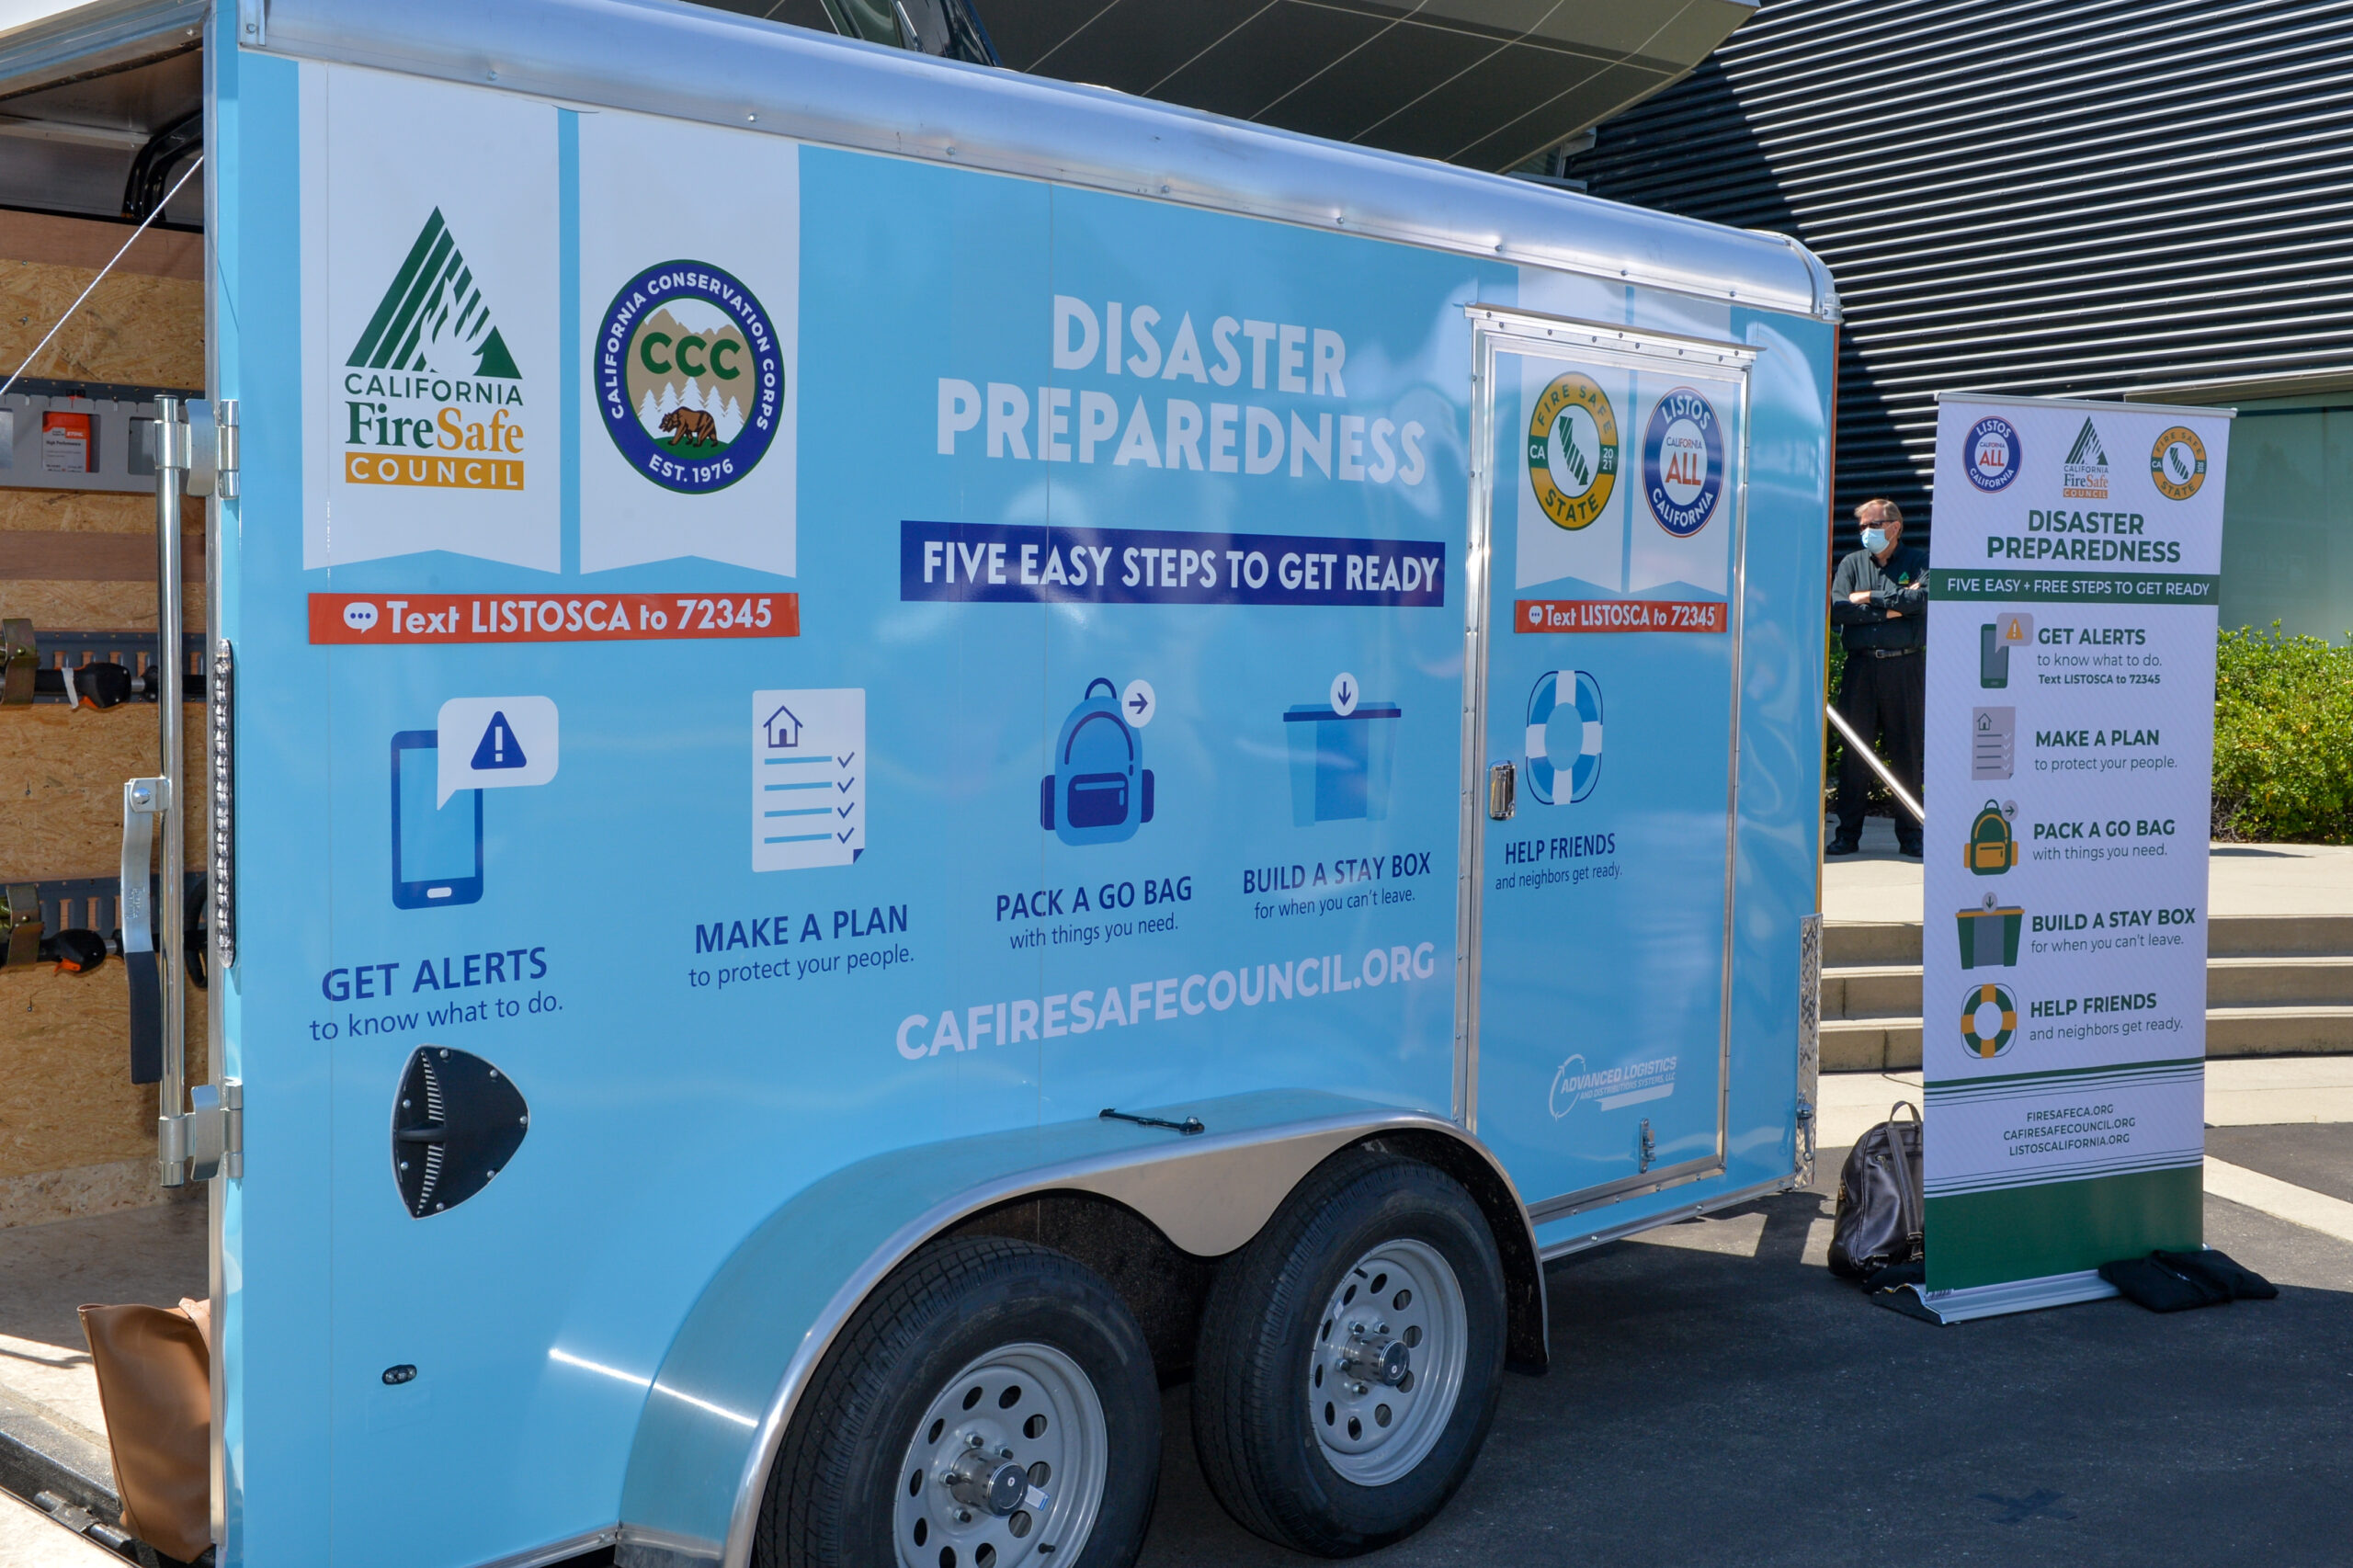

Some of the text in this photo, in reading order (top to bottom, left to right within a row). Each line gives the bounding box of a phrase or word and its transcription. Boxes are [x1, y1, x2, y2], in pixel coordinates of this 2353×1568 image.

[605, 272, 775, 430] CALIFORNIA CONSERVATION CORPS
[641, 332, 741, 381] CCC
[1053, 294, 1346, 398] DISASTER
[345, 373, 524, 406] CALIFORNIA
[1538, 384, 1611, 434] FIRE SAFE
[1661, 394, 1711, 430] LISTOS
[345, 401, 524, 454] FireSafe
[938, 377, 1426, 486] PREPAREDNESS
[1976, 420, 2011, 437] LISTOS
[1529, 445, 1545, 460] CA
[1603, 448, 1613, 459] 20
[1666, 436, 1702, 449] CALIFORNIA
[2155, 432, 2201, 454] FIRE SAFE
[649, 454, 733, 483] EST. 1976
[1603, 460, 1612, 471] 21
[1665, 452, 1701, 486] ALL
[1979, 449, 2005, 467] ALL
[2063, 465, 2109, 473] CALIFORNIA
[2152, 460, 2162, 469] CA
[350, 457, 518, 486] COUNCIL
[1970, 467, 2014, 488] CALIFORNIA
[2063, 473, 2109, 488] FireSafe
[2064, 489, 2107, 497] COUNCIL
[2161, 481, 2195, 497] STATE
[1545, 488, 1599, 522] STATE
[1653, 487, 1714, 528] CALIFORNIA
[2029, 509, 2144, 535] DISASTER
[1987, 536, 2181, 562] PREPAREDNESS
[924, 540, 1439, 593] FIVE EASY STEPS TO GET READY
[1948, 578, 1980, 592] FIVE
[1985, 579, 2020, 593] EASY
[2034, 579, 2068, 593] FREE
[2072, 580, 2112, 594] STEPS
[2114, 581, 2133, 595] TO
[2136, 582, 2163, 595] GET
[2165, 582, 2210, 597] READY
[387, 598, 771, 633] Text LISTOSCA to 72345
[1545, 604, 1715, 627] Text LISTOSCA to 72345
[2038, 628, 2146, 645] GET ALERTS
[2037, 653, 2162, 666] to know what to do.
[2038, 674, 2161, 685] Text LISTOSCA to 72345
[2036, 729, 2159, 747] MAKE A PLAN
[2034, 756, 2177, 773] to protect your people.
[2033, 819, 2176, 840] PACK A GO BAG
[1505, 833, 1615, 865] HELP FRIENDS
[2032, 845, 2167, 861] with things you need.
[1244, 851, 1431, 894] BUILD A STAY BOX
[1495, 862, 1622, 891] and neighbors get ready.
[996, 876, 1193, 923] PACK A GO BAG
[1254, 901, 1275, 920] for
[1279, 897, 1315, 917] when
[1319, 896, 1343, 917] you
[1381, 887, 1415, 906] leave.
[695, 903, 908, 954] MAKE A PLAN
[1009, 913, 1178, 950] with things you need.
[2031, 908, 2196, 932] BUILD A STAY BOX
[2030, 940, 2047, 953] for
[2052, 938, 2087, 952] when
[2091, 939, 2112, 952] you
[2148, 934, 2184, 946] leave.
[321, 947, 548, 1003] GET ALERTS
[688, 944, 914, 990] to protect your people.
[895, 941, 1435, 1062] CAFIRESAFECOUNCIL.ORG
[2030, 993, 2157, 1018] HELP FRIENDS
[309, 990, 563, 1042] to know what to do.
[2029, 1017, 2183, 1041] and neighbors get ready.
[1561, 1056, 1677, 1094] ADVANCED LOGISTICS
[1580, 1089, 1593, 1100] AND
[1666, 1072, 1677, 1082] LLC
[2027, 1103, 2113, 1122] FIRESAFECA.ORG
[2003, 1117, 2135, 1141] CAFIRESAFECOUNCIL.ORG
[2009, 1133, 2130, 1156] LISTOSCALIFORNIA.ORG
